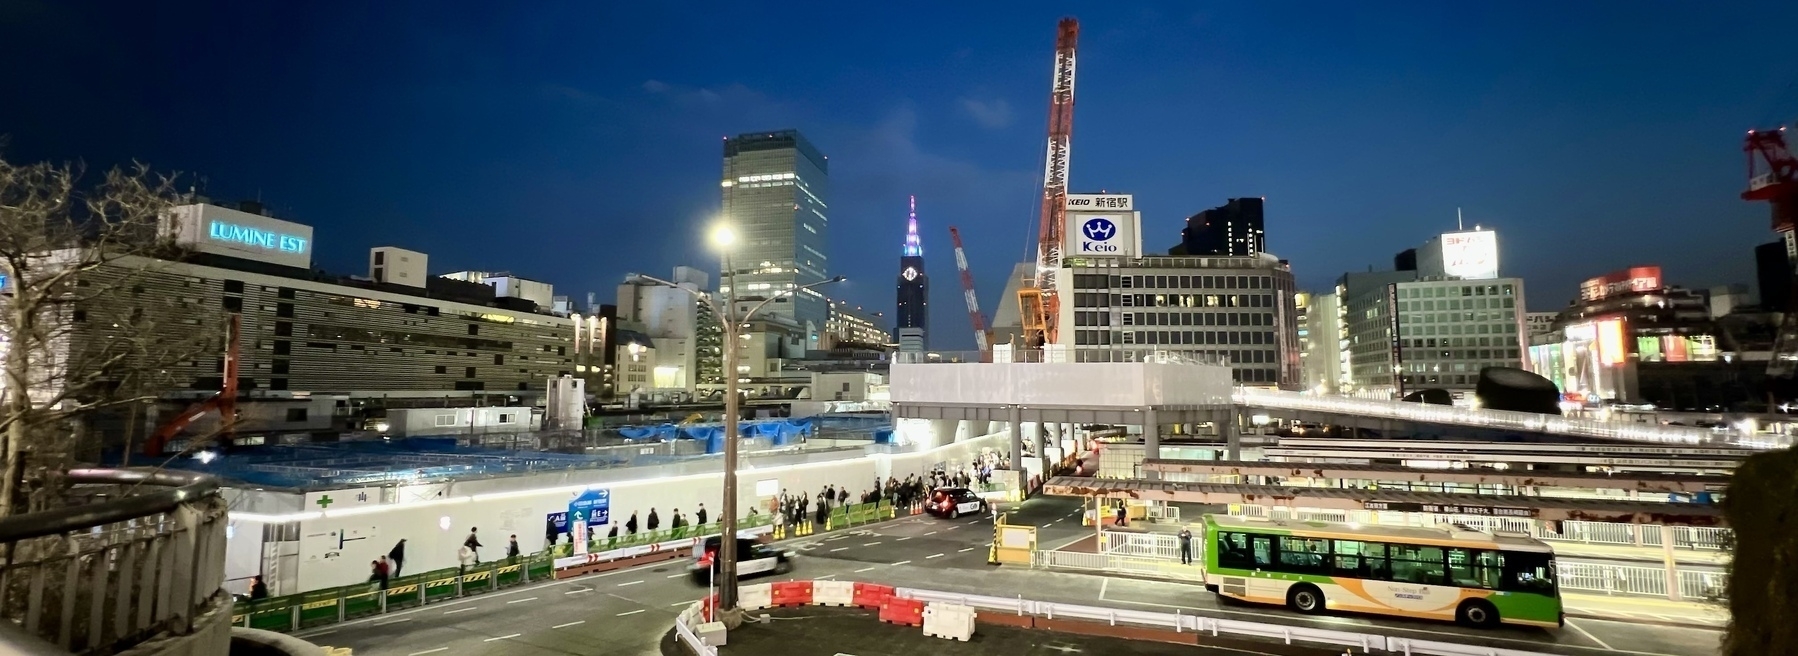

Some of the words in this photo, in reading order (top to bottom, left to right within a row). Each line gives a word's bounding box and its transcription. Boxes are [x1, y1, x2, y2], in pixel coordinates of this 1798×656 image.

[1095, 197, 1128, 208] 新宿駅
[210, 222, 275, 248] LUMINE
[280, 236, 306, 254] EST
[1083, 241, 1117, 252] Keio
